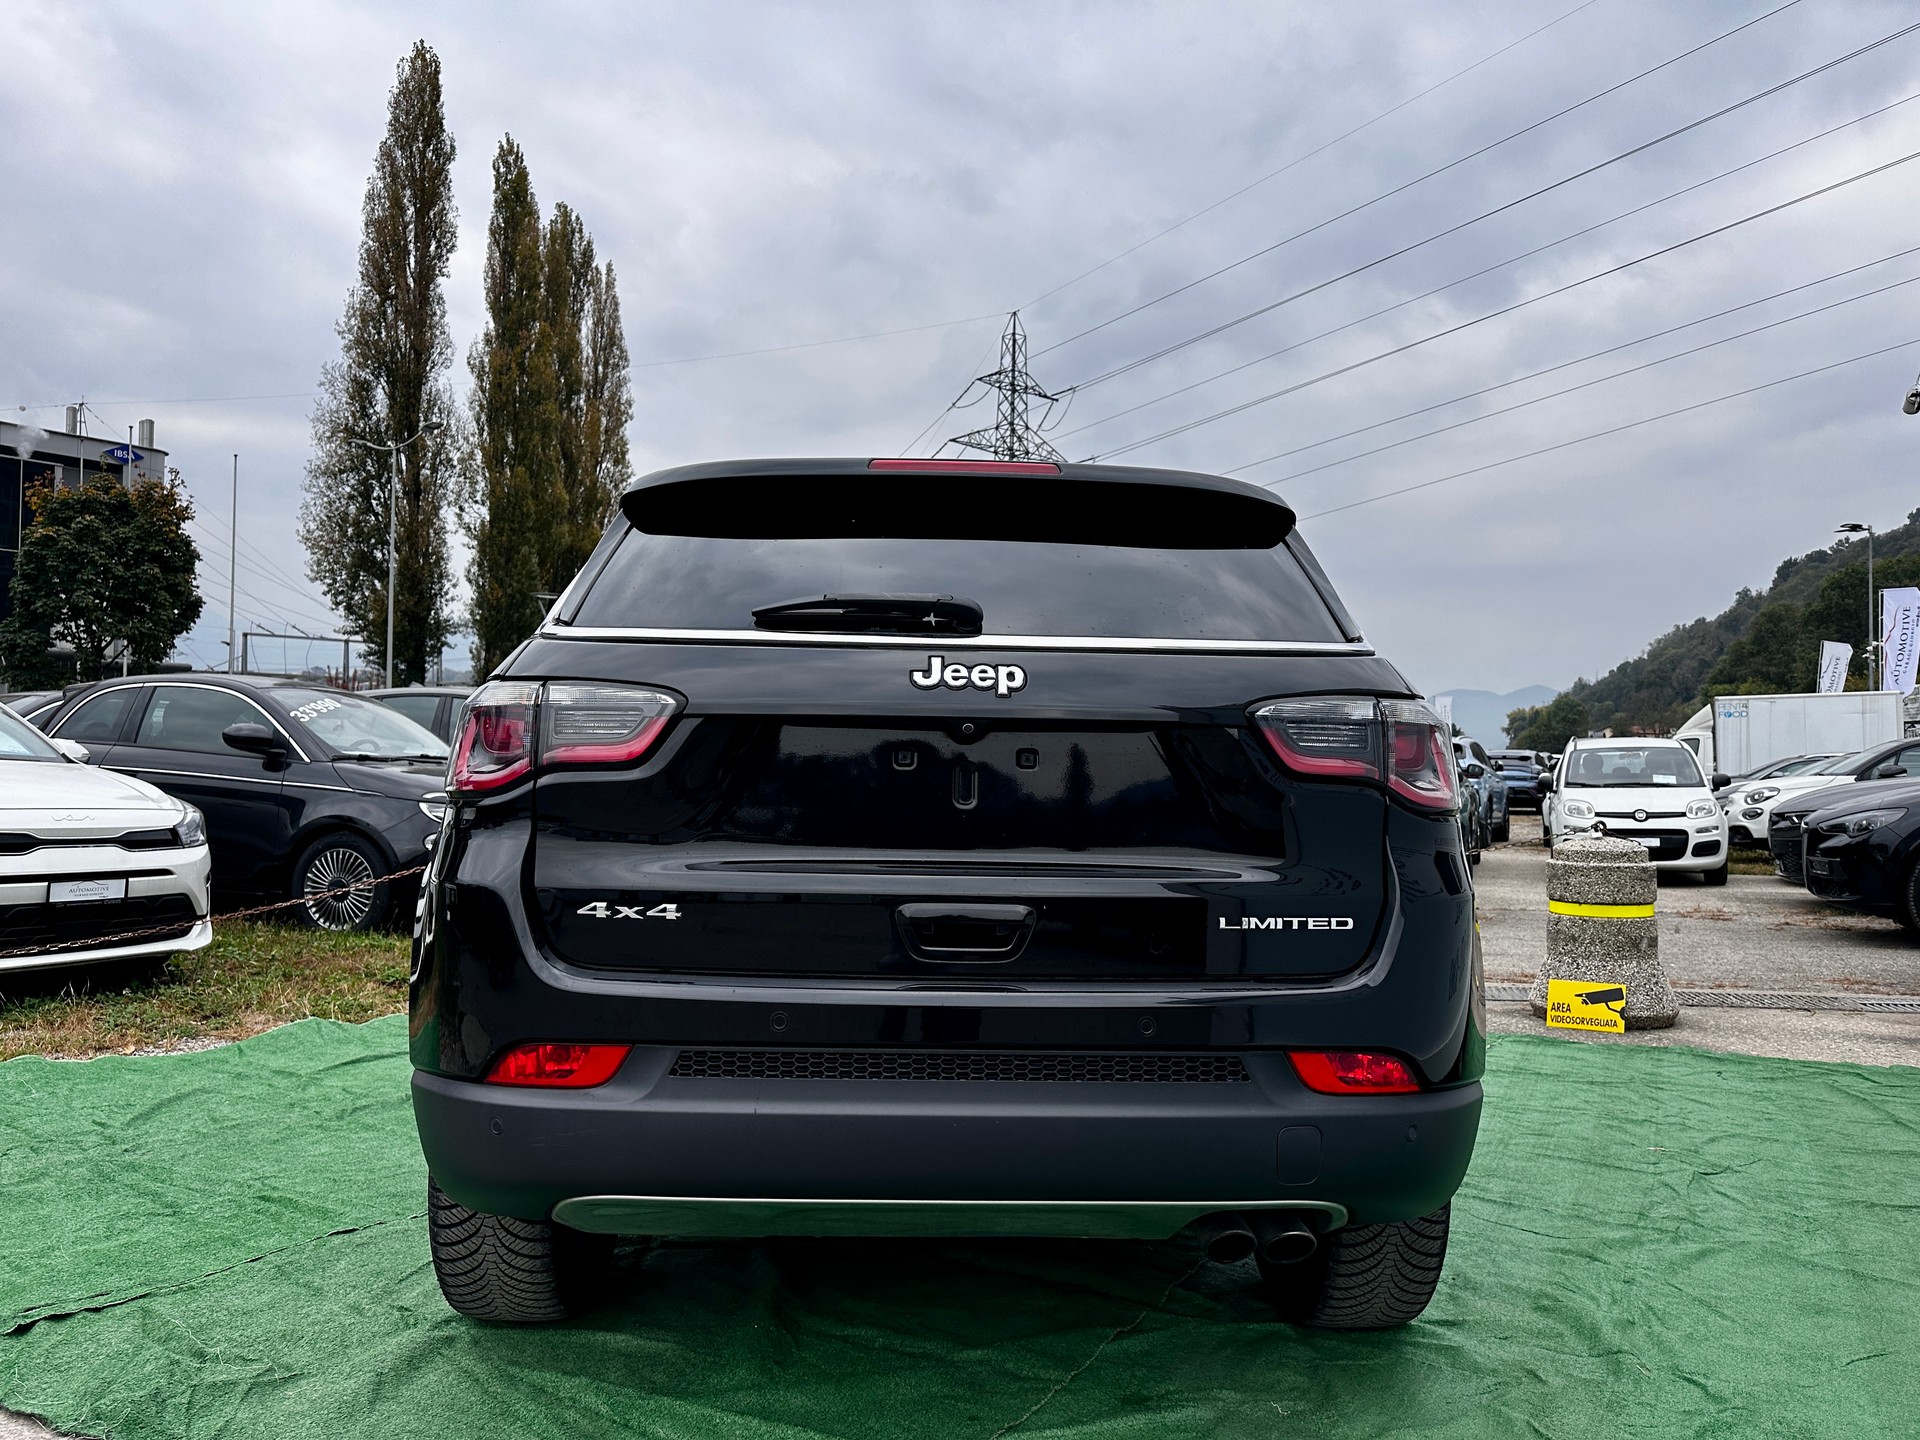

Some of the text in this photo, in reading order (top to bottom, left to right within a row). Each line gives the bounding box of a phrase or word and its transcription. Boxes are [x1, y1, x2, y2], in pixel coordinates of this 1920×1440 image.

[114, 449, 136, 460] IBSA
[1893, 606, 1911, 685] AUTOMOTIVE
[910, 655, 1027, 697] Jeep
[289, 698, 342, 722] 33'990
[577, 901, 682, 920] 4x4
[1219, 917, 1354, 930] LIMITED
[1550, 1002, 1571, 1013] AREA
[1550, 1014, 1618, 1028] VIDEOSORVEGLIATA
